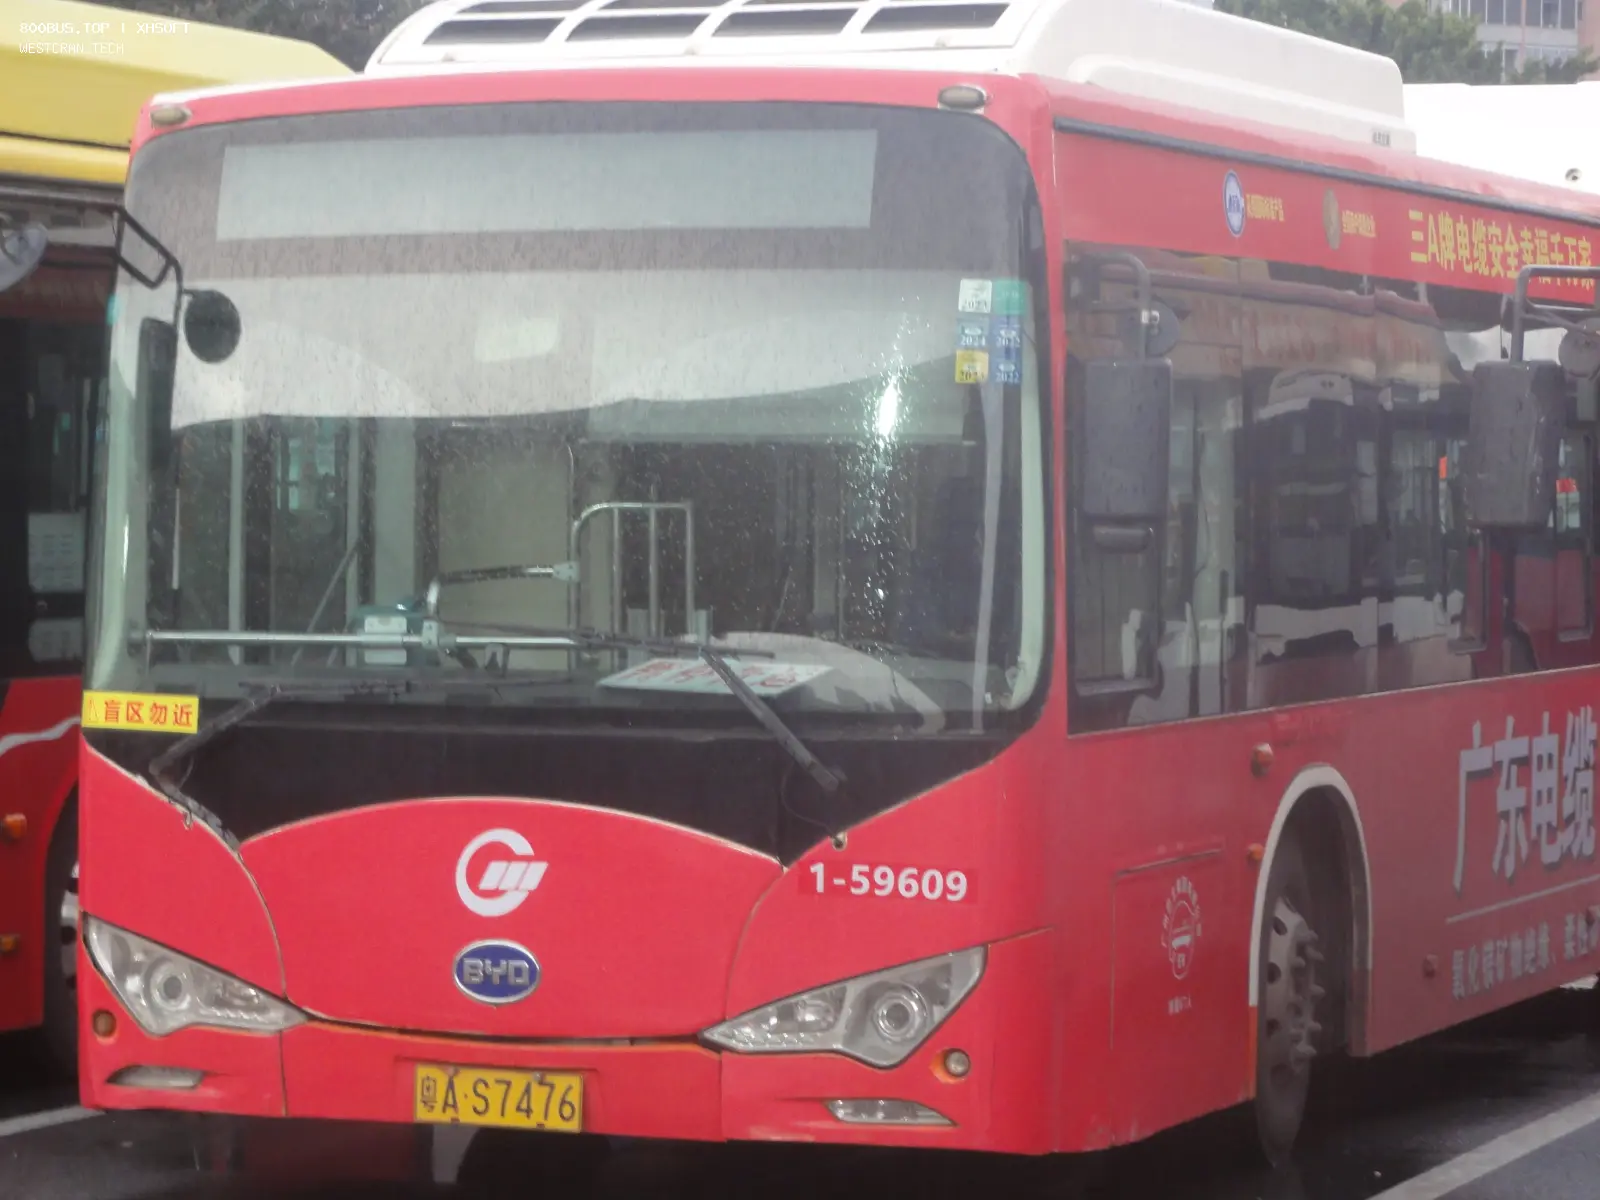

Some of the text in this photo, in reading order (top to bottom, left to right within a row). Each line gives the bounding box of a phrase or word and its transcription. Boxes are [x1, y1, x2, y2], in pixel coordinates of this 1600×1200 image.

[104, 699, 193, 727] 盲区勿近
[1453, 704, 1598, 893] 广东电缆
[810, 862, 968, 902] 1-59609
[462, 957, 531, 986] BYD
